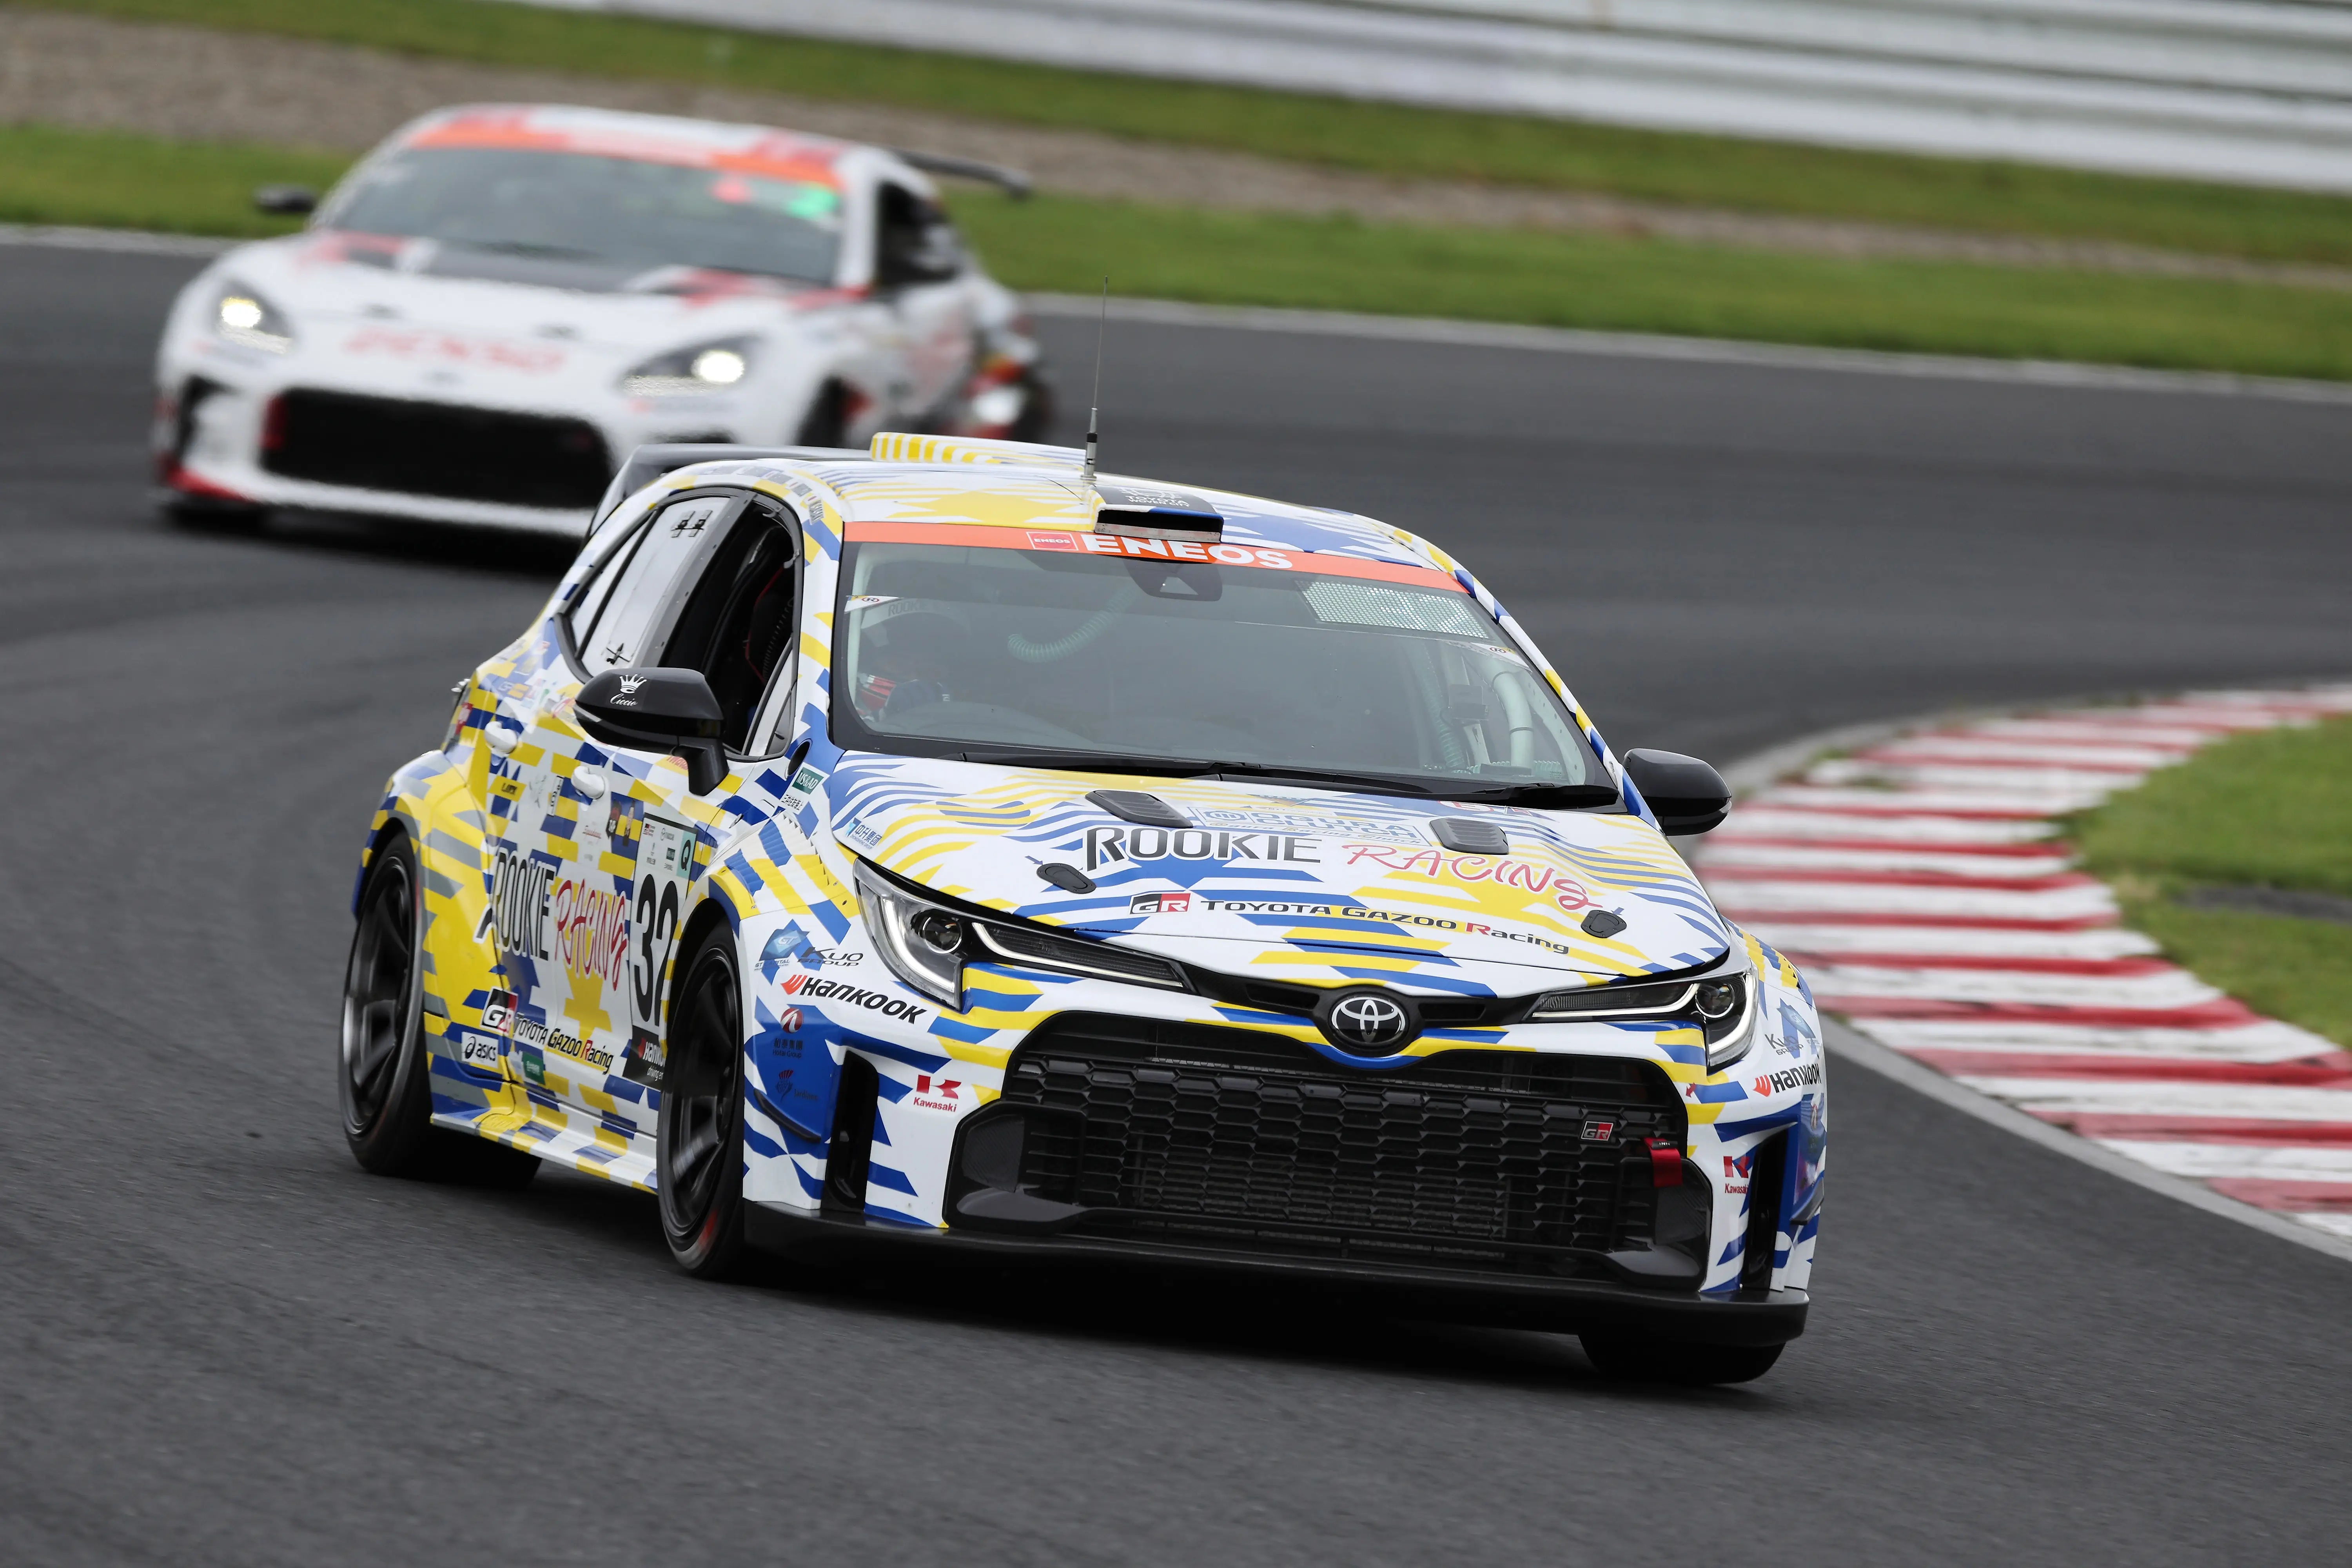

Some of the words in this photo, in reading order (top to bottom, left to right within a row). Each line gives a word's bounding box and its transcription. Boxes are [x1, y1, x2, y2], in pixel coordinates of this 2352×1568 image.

[1125, 495, 1189, 505] TOYOTA
[1082, 534, 1292, 568] ENEOS
[796, 772, 818, 789] MS&AD
[1251, 813, 1412, 832] OGURA
[1257, 818, 1417, 838] CLUTCH
[855, 825, 882, 846] 中升集团
[681, 840, 691, 871] Q
[1086, 827, 1322, 871] ROOKIE
[1342, 845, 1603, 910] RACING
[475, 852, 554, 961] ROOKIE
[555, 879, 627, 991] RACING
[1132, 900, 1188, 913] GR
[1201, 900, 1332, 915] TOYOTA
[1341, 907, 1456, 929] GAZOO
[1465, 922, 1569, 954] Racing
[635, 874, 678, 1027] 32
[476, 1043, 496, 1061] asics
[514, 1013, 548, 1045] TOYOTA
[548, 1028, 582, 1056] GAZOO
[580, 1040, 613, 1074] Racing
[913, 1098, 957, 1112] Kawasaki
[1584, 1129, 1609, 1139] GR
